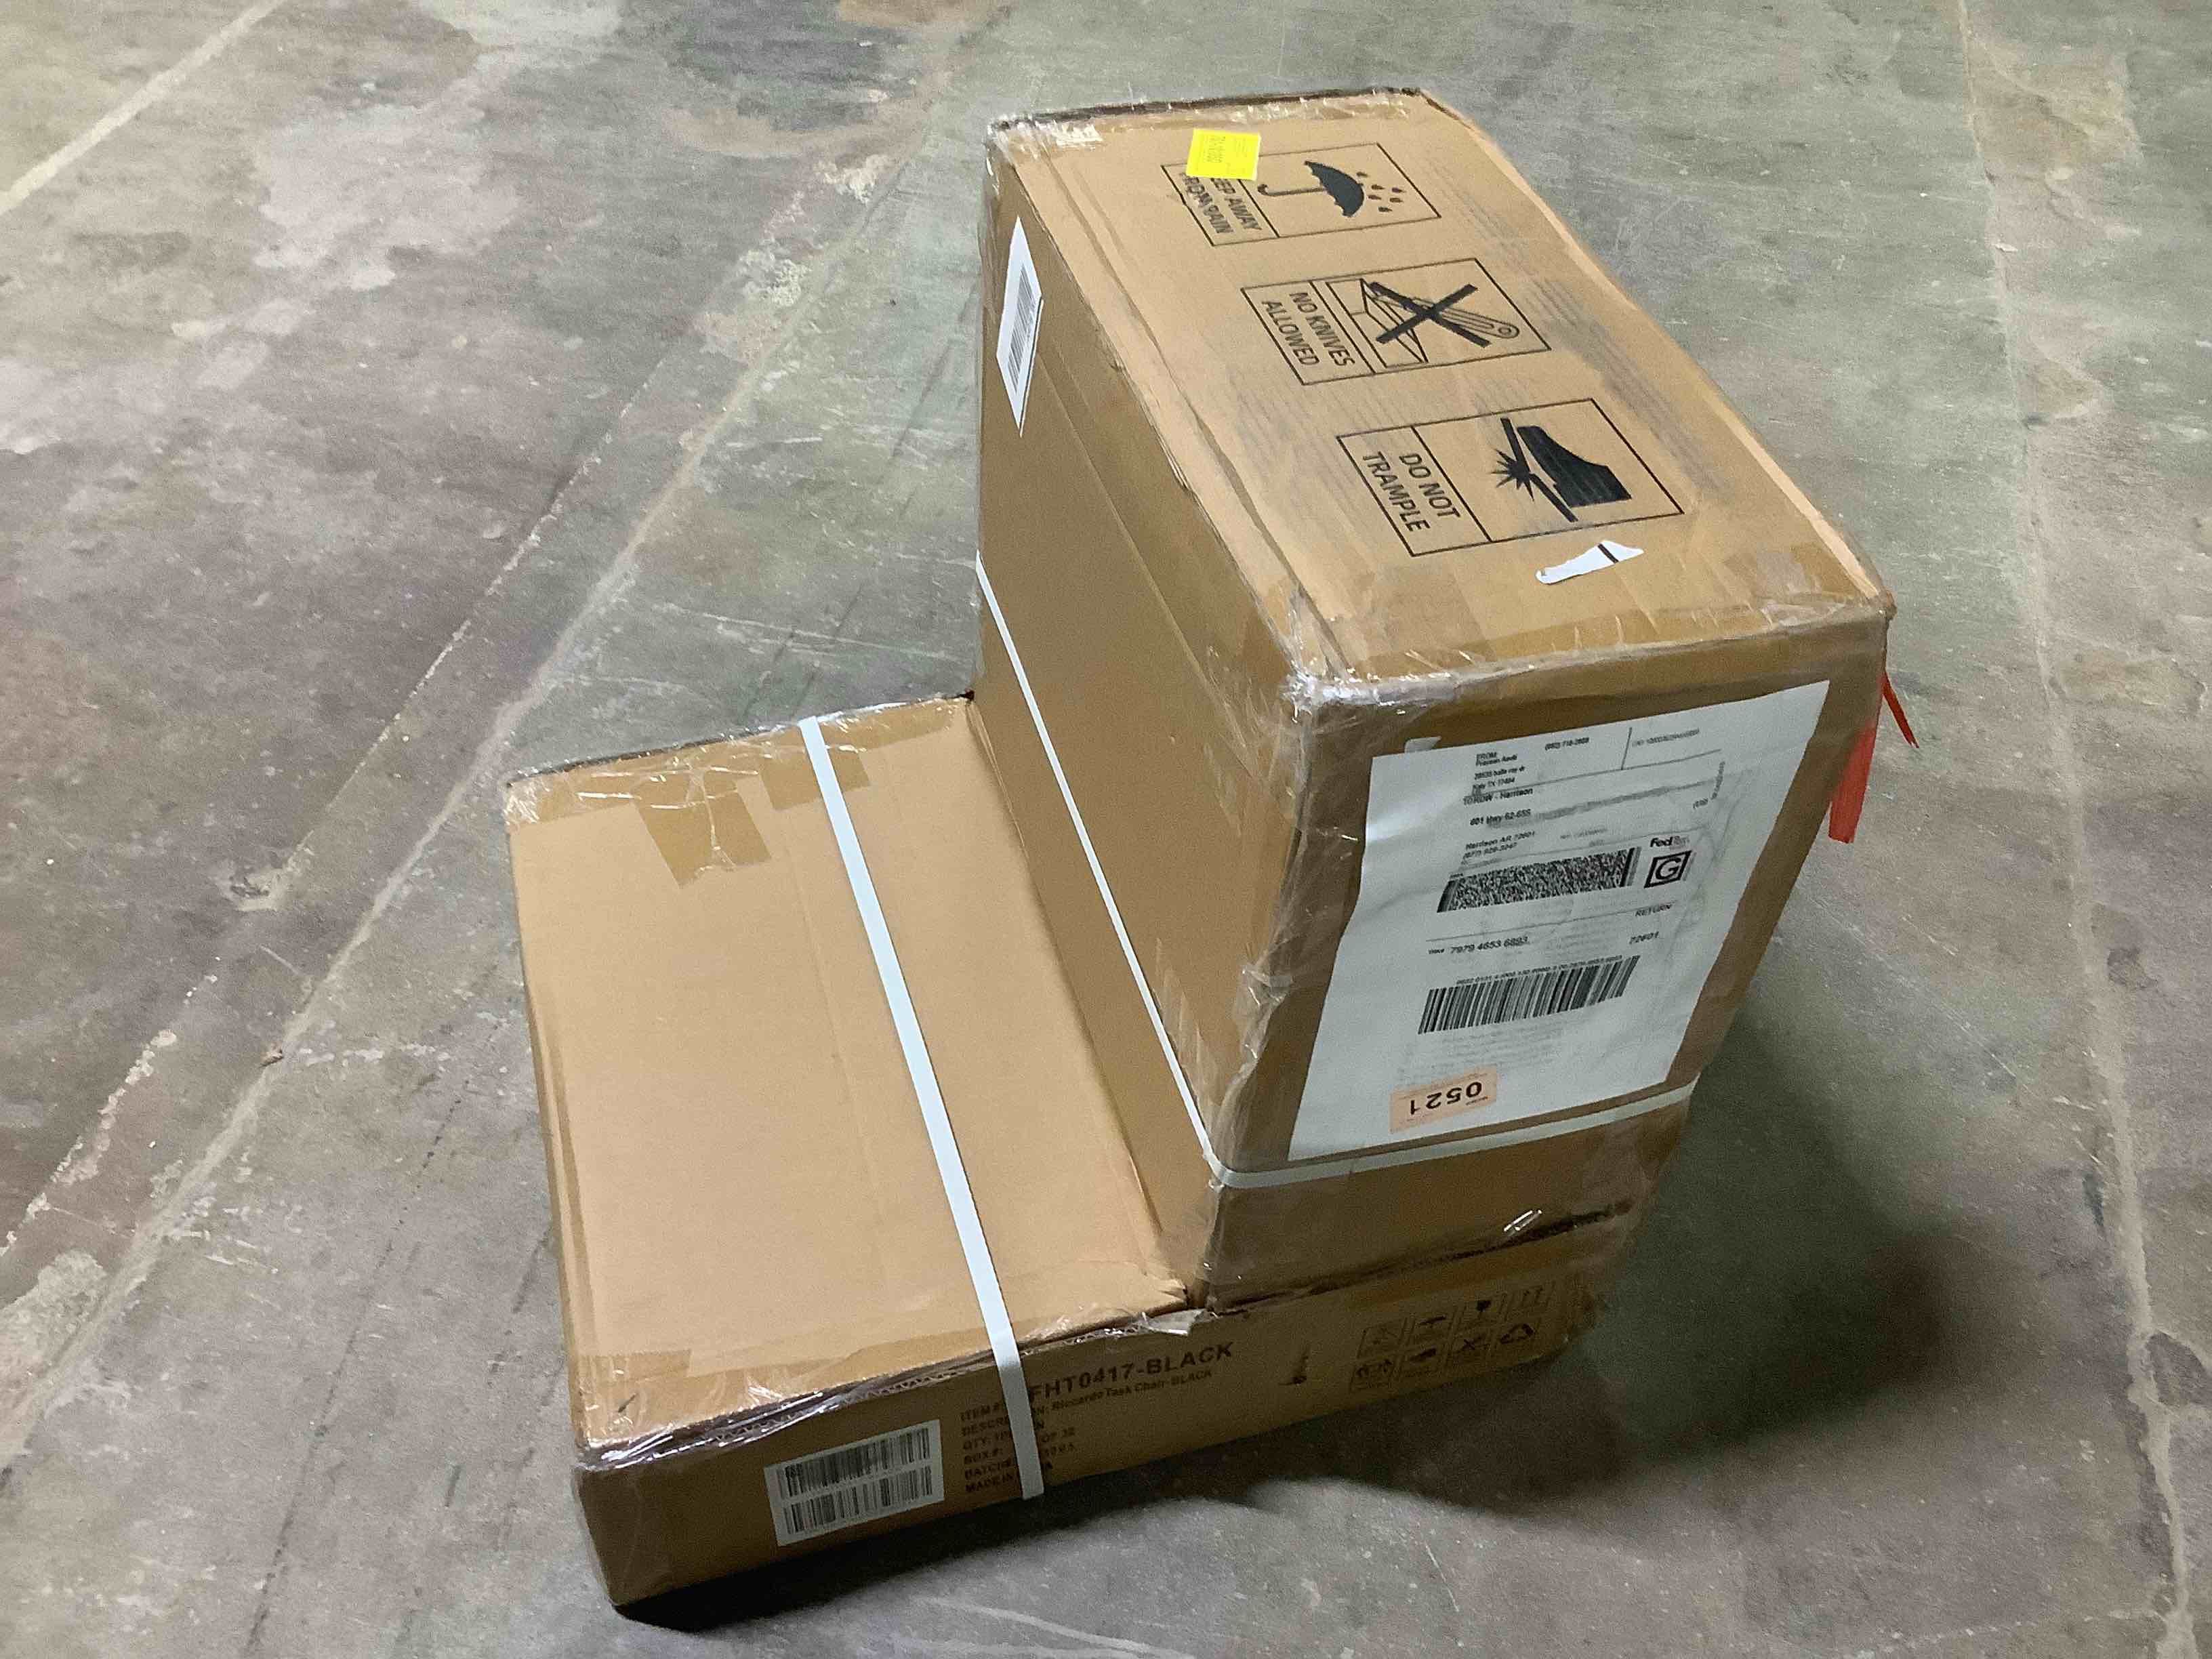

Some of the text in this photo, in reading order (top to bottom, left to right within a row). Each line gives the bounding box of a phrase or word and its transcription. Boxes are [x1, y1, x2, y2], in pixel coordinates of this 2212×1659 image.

[1224, 198, 1263, 231] AWAY
[1261, 301, 1319, 365] ALLOWED
[1290, 291, 1355, 367] NO KNIVES
[1362, 451, 1430, 532] TRAMPLE
[1399, 453, 1460, 518] DO NOT
[1635, 902, 1674, 916] RETURN
[1410, 1081, 1483, 1115] 0521
[1029, 1341, 1233, 1405] FHT0417-BLACK
